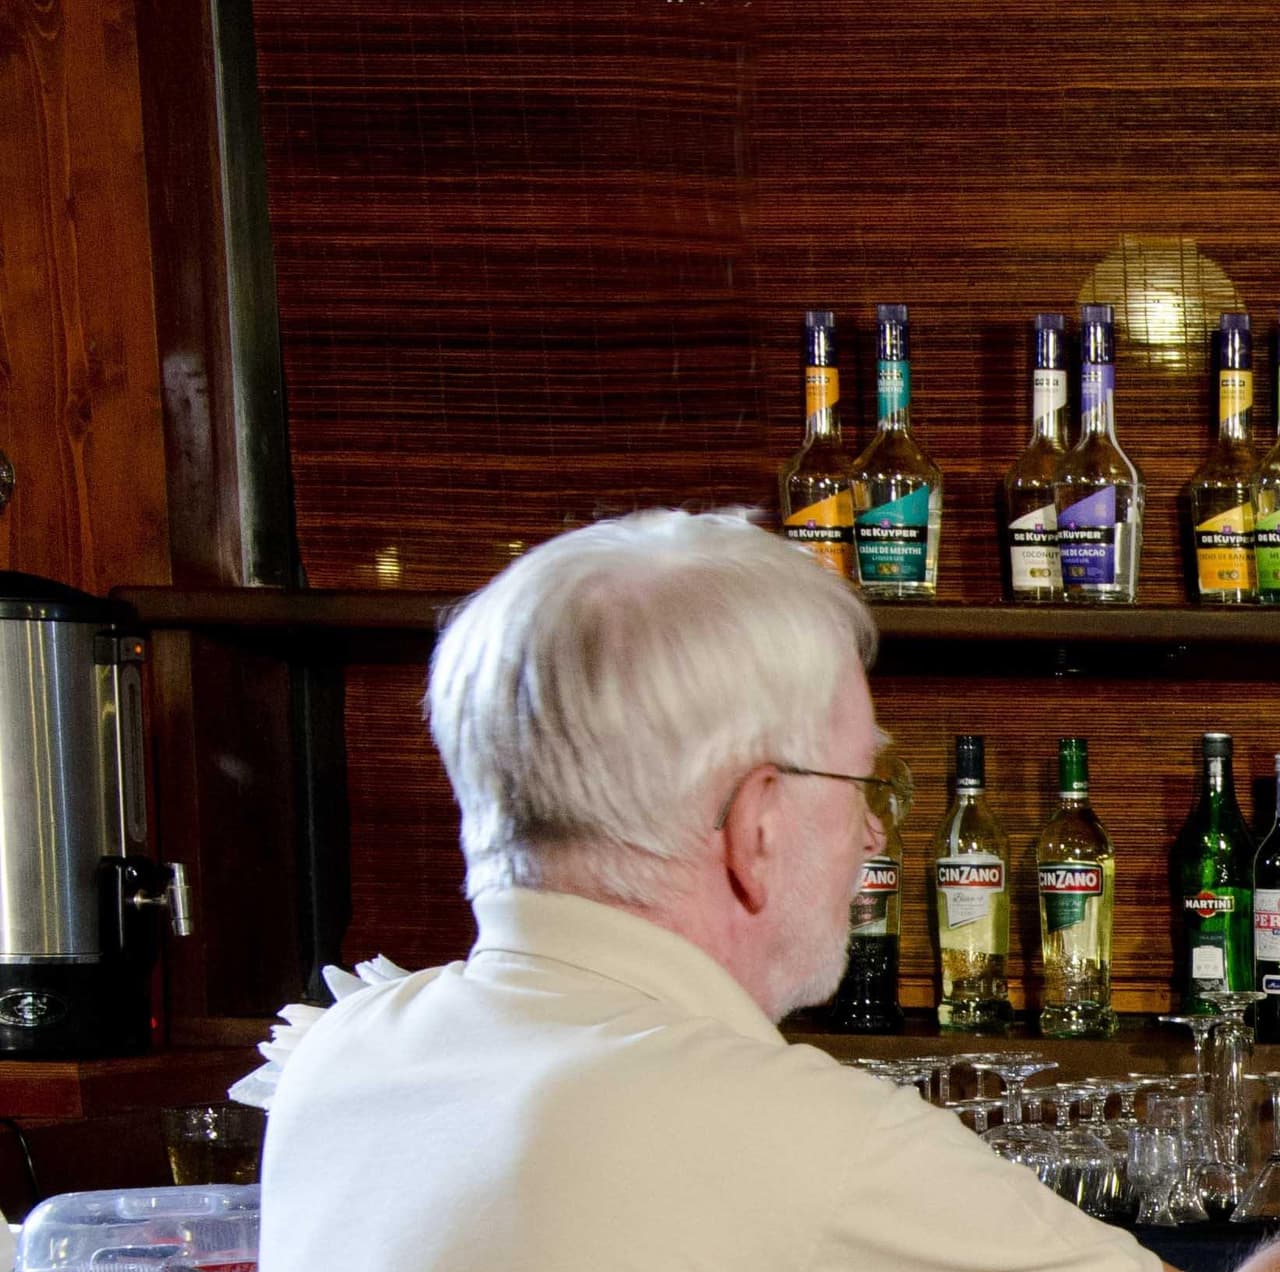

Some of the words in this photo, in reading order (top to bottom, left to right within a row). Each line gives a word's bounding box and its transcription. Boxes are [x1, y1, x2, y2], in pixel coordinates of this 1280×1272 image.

[799, 528, 841, 538] KUYPER
[873, 527, 917, 538] KUYPER
[1063, 530, 1102, 539] KUYPER
[890, 547, 922, 555] MENTHE
[1022, 551, 1058, 559] COCONUT
[1079, 549, 1105, 557] CACAO
[861, 868, 896, 886] ZANO
[940, 867, 999, 884] CINZANO
[1039, 868, 1097, 888] CINZANO
[1186, 900, 1232, 909] MARTINI
